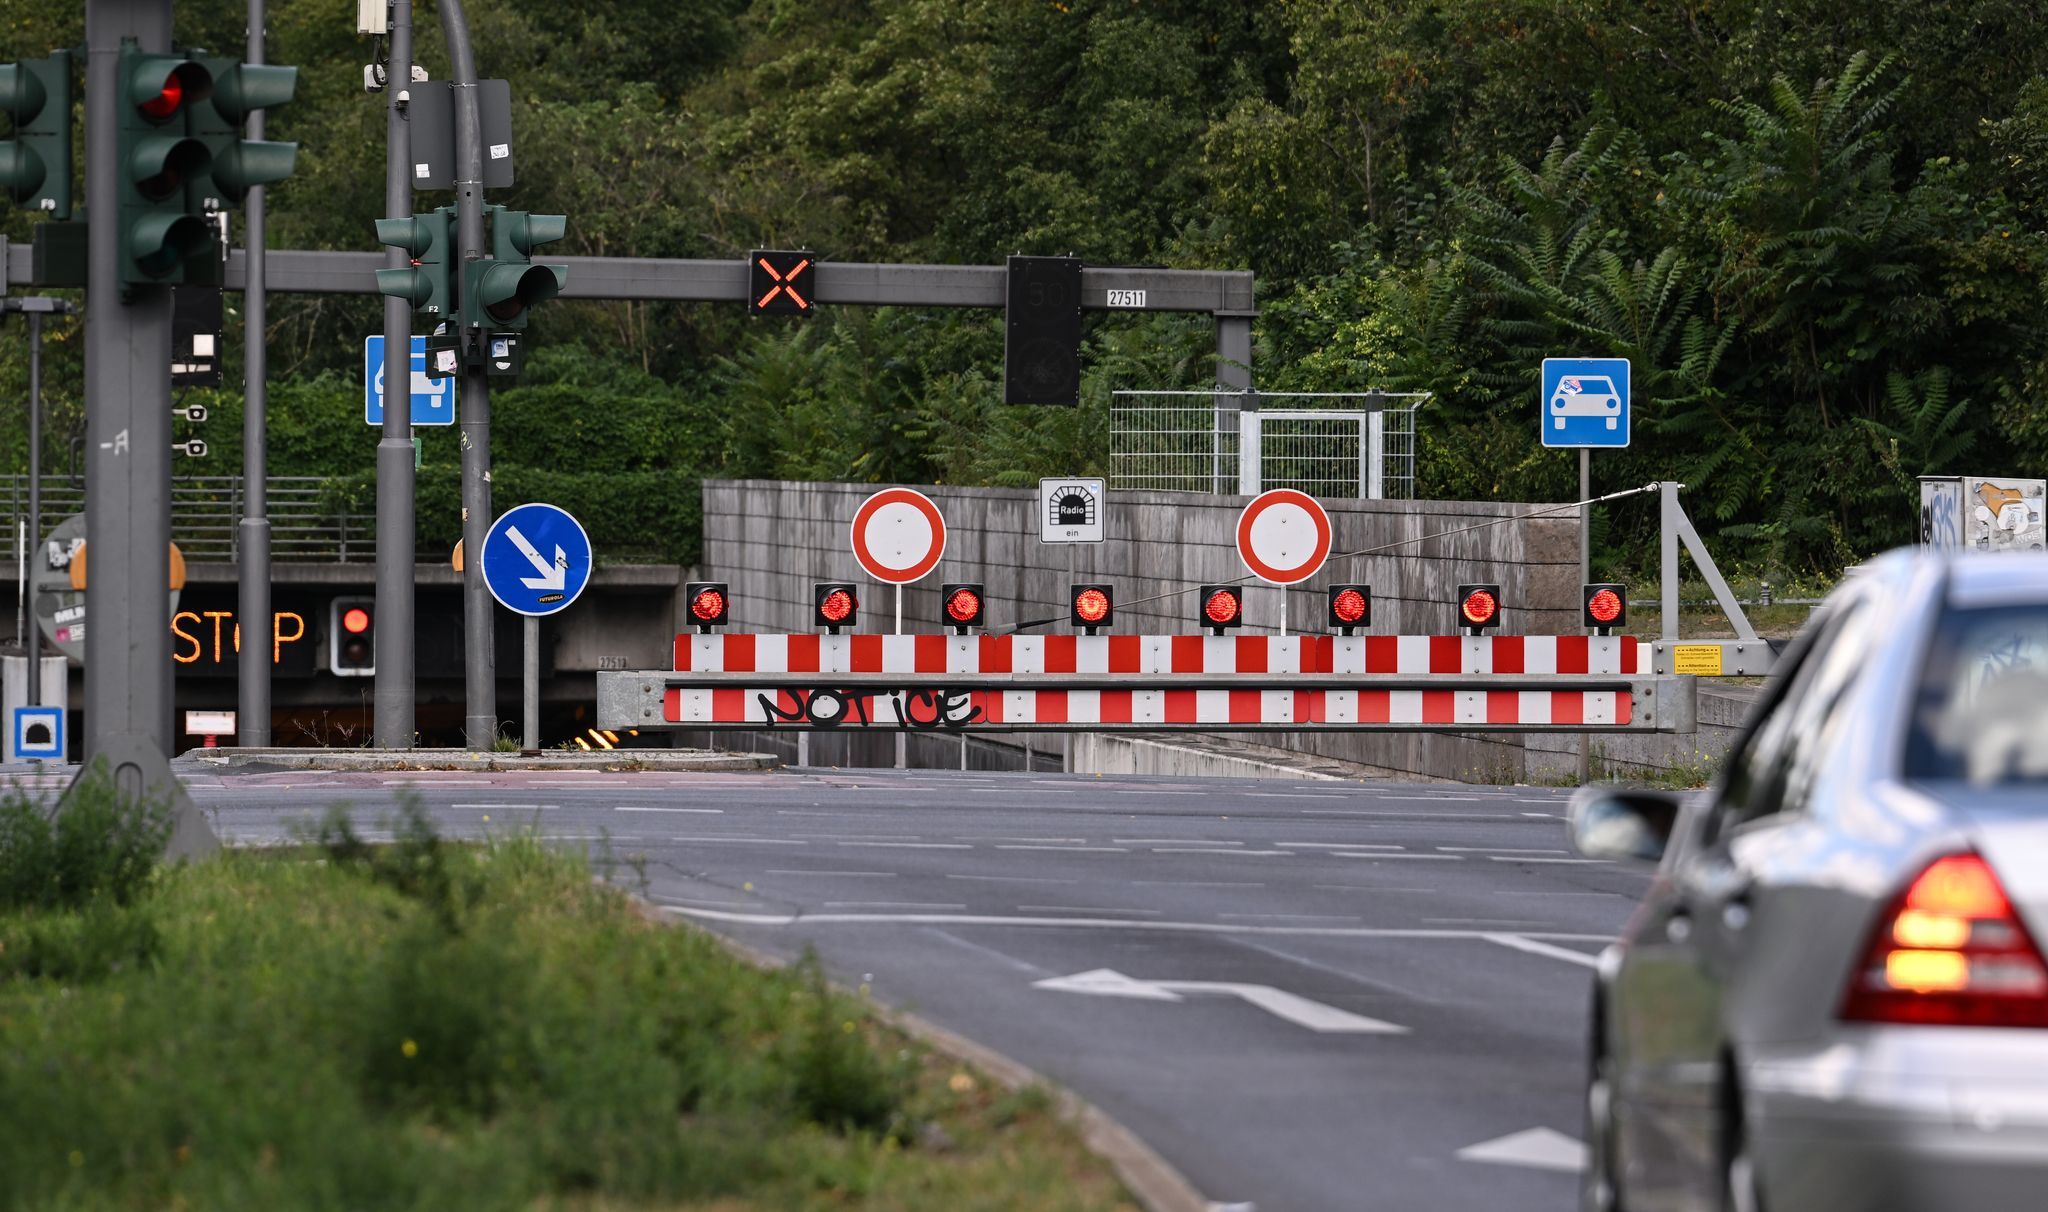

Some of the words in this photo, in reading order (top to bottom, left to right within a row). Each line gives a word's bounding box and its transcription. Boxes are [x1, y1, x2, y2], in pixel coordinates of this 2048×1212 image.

[1110, 291, 1143, 306] 27511
[1060, 506, 1085, 515] Radio
[1066, 529, 1079, 537] ein
[172, 611, 305, 663] STP
